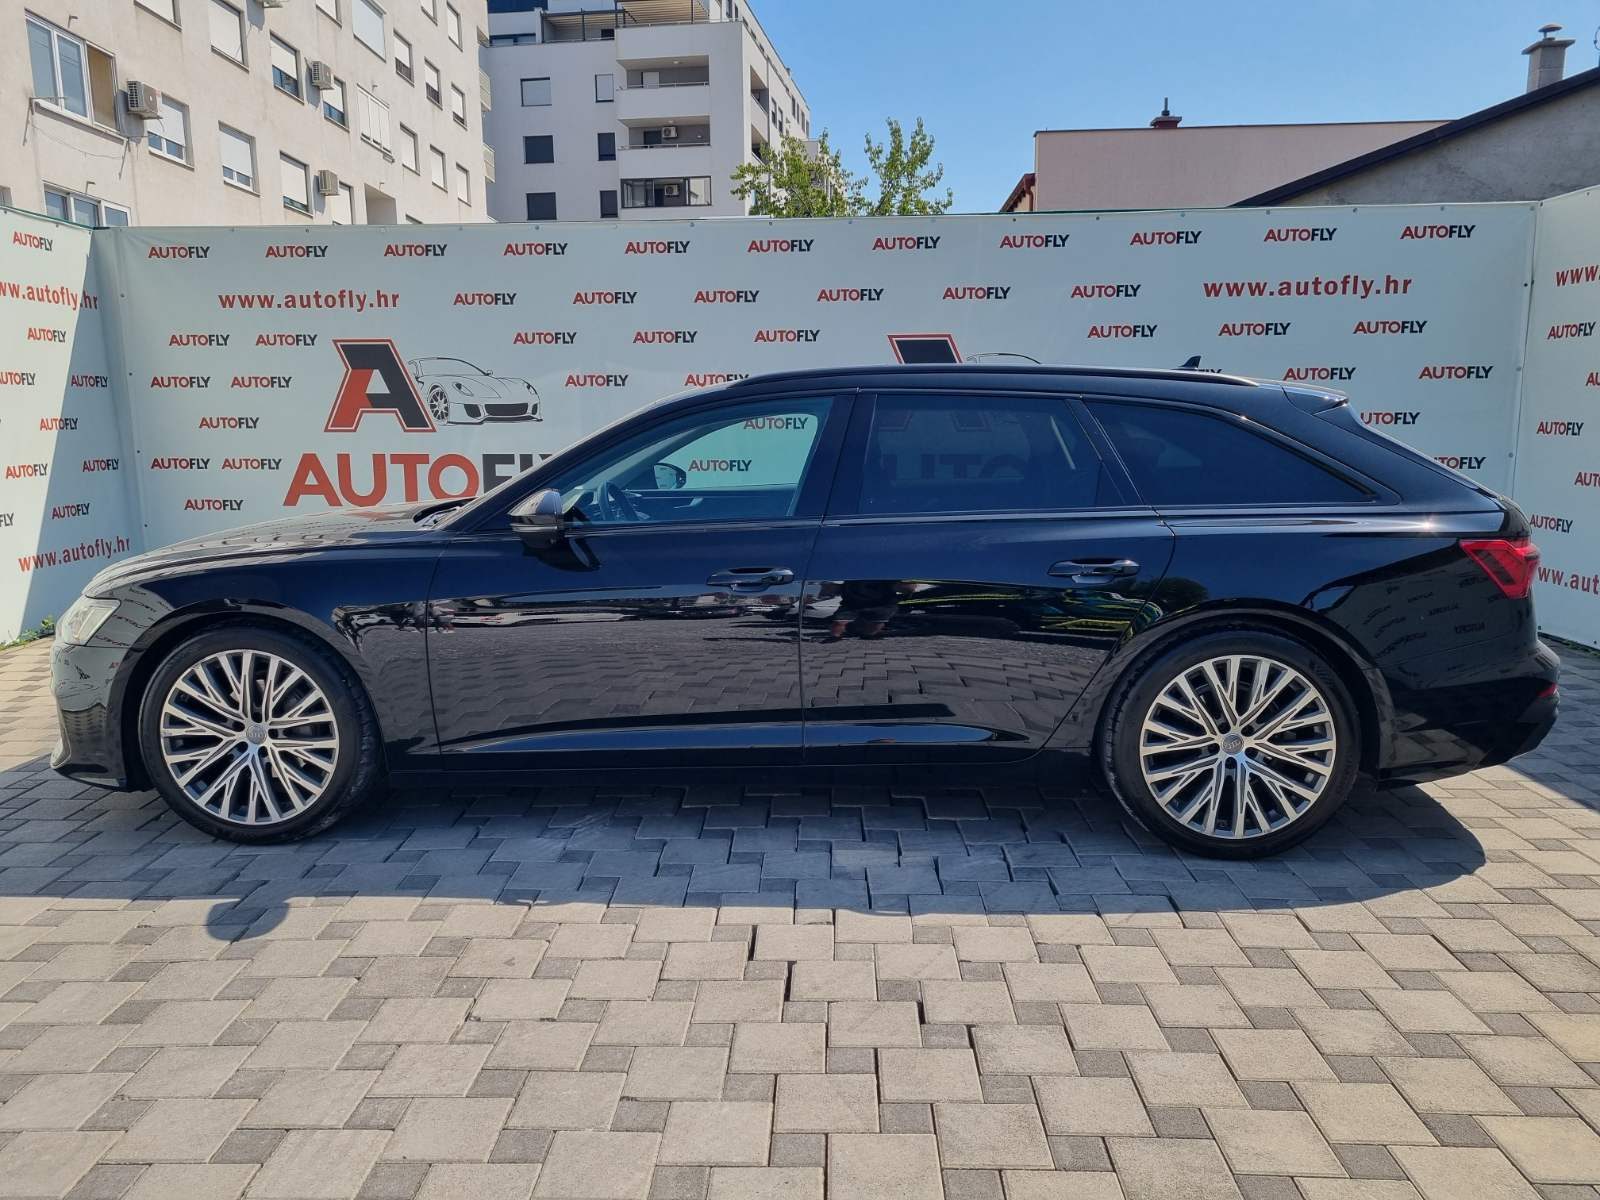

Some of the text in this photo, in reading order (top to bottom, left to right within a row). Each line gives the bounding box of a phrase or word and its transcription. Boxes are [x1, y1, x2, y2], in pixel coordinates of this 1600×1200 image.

[1130, 231, 1202, 245] AUTOFLY
[1264, 228, 1337, 241] AUTOFLY
[1400, 225, 1475, 239] AUTOFLY
[13, 231, 53, 251] AUTOFLY
[625, 241, 690, 254] AUTOFLY
[748, 239, 814, 252] AUTOFLY
[872, 236, 940, 250] AUTOFLY
[1000, 235, 1069, 248] AUTOFLY
[148, 246, 210, 258] AUTOFLY
[266, 246, 328, 257] AUTOFLY
[384, 244, 447, 256] AUTOFLY
[504, 243, 568, 256] AUTOFLY
[943, 287, 1011, 299] AUTOFLY
[1071, 284, 1141, 298] AUTOFLY
[1204, 275, 1412, 299] www.autofly.hr
[0, 282, 98, 310] ww.autofly.hr
[218, 290, 399, 312] www.autofly.hr
[453, 293, 516, 305] AUTOFLY
[573, 292, 637, 304] AUTOFLY
[694, 290, 759, 303] AUTOFLY
[817, 289, 884, 301] AUTOFLY
[1088, 325, 1157, 338] AUTOFLY
[1219, 323, 1291, 336] AUTOFLY
[1353, 321, 1427, 334] AUTOFLY
[1547, 322, 1596, 339] AUTOFLY
[28, 328, 66, 343] AUTOFLY
[169, 334, 230, 346] AUTOFLY
[256, 334, 317, 346] AUTOFLY
[513, 332, 576, 344] AUTOFLY
[633, 331, 697, 343] AUTOFLY
[754, 330, 820, 342] AUTOFLY
[0, 371, 36, 386] UTOFLY
[1284, 367, 1356, 381] AUTOFLY
[1419, 366, 1493, 379] AUTOFLY
[71, 375, 108, 387] AUTOFLY
[151, 376, 211, 388] AUTOFLY
[231, 376, 292, 388] AUTOFLY
[565, 375, 628, 387] AUTOFLY
[40, 418, 78, 431] AUTOFLY
[199, 417, 259, 429] AUTOFLY
[744, 417, 808, 430] AUTOFLY
[1361, 412, 1420, 425] UTOFLY
[1537, 422, 1584, 436] AUTOFLY
[83, 459, 119, 472] AUTOFLY
[151, 458, 210, 469] AUTOFLY
[222, 458, 282, 470] AUTOFLY
[688, 459, 752, 472] AUTOFLY
[6, 463, 48, 479] AUTOFLY
[52, 503, 90, 519] AUTOFLY
[184, 500, 243, 510] AUTOFLY
[1530, 514, 1573, 533] AUTOFLY
[18, 536, 130, 572] www.autofly.hr
